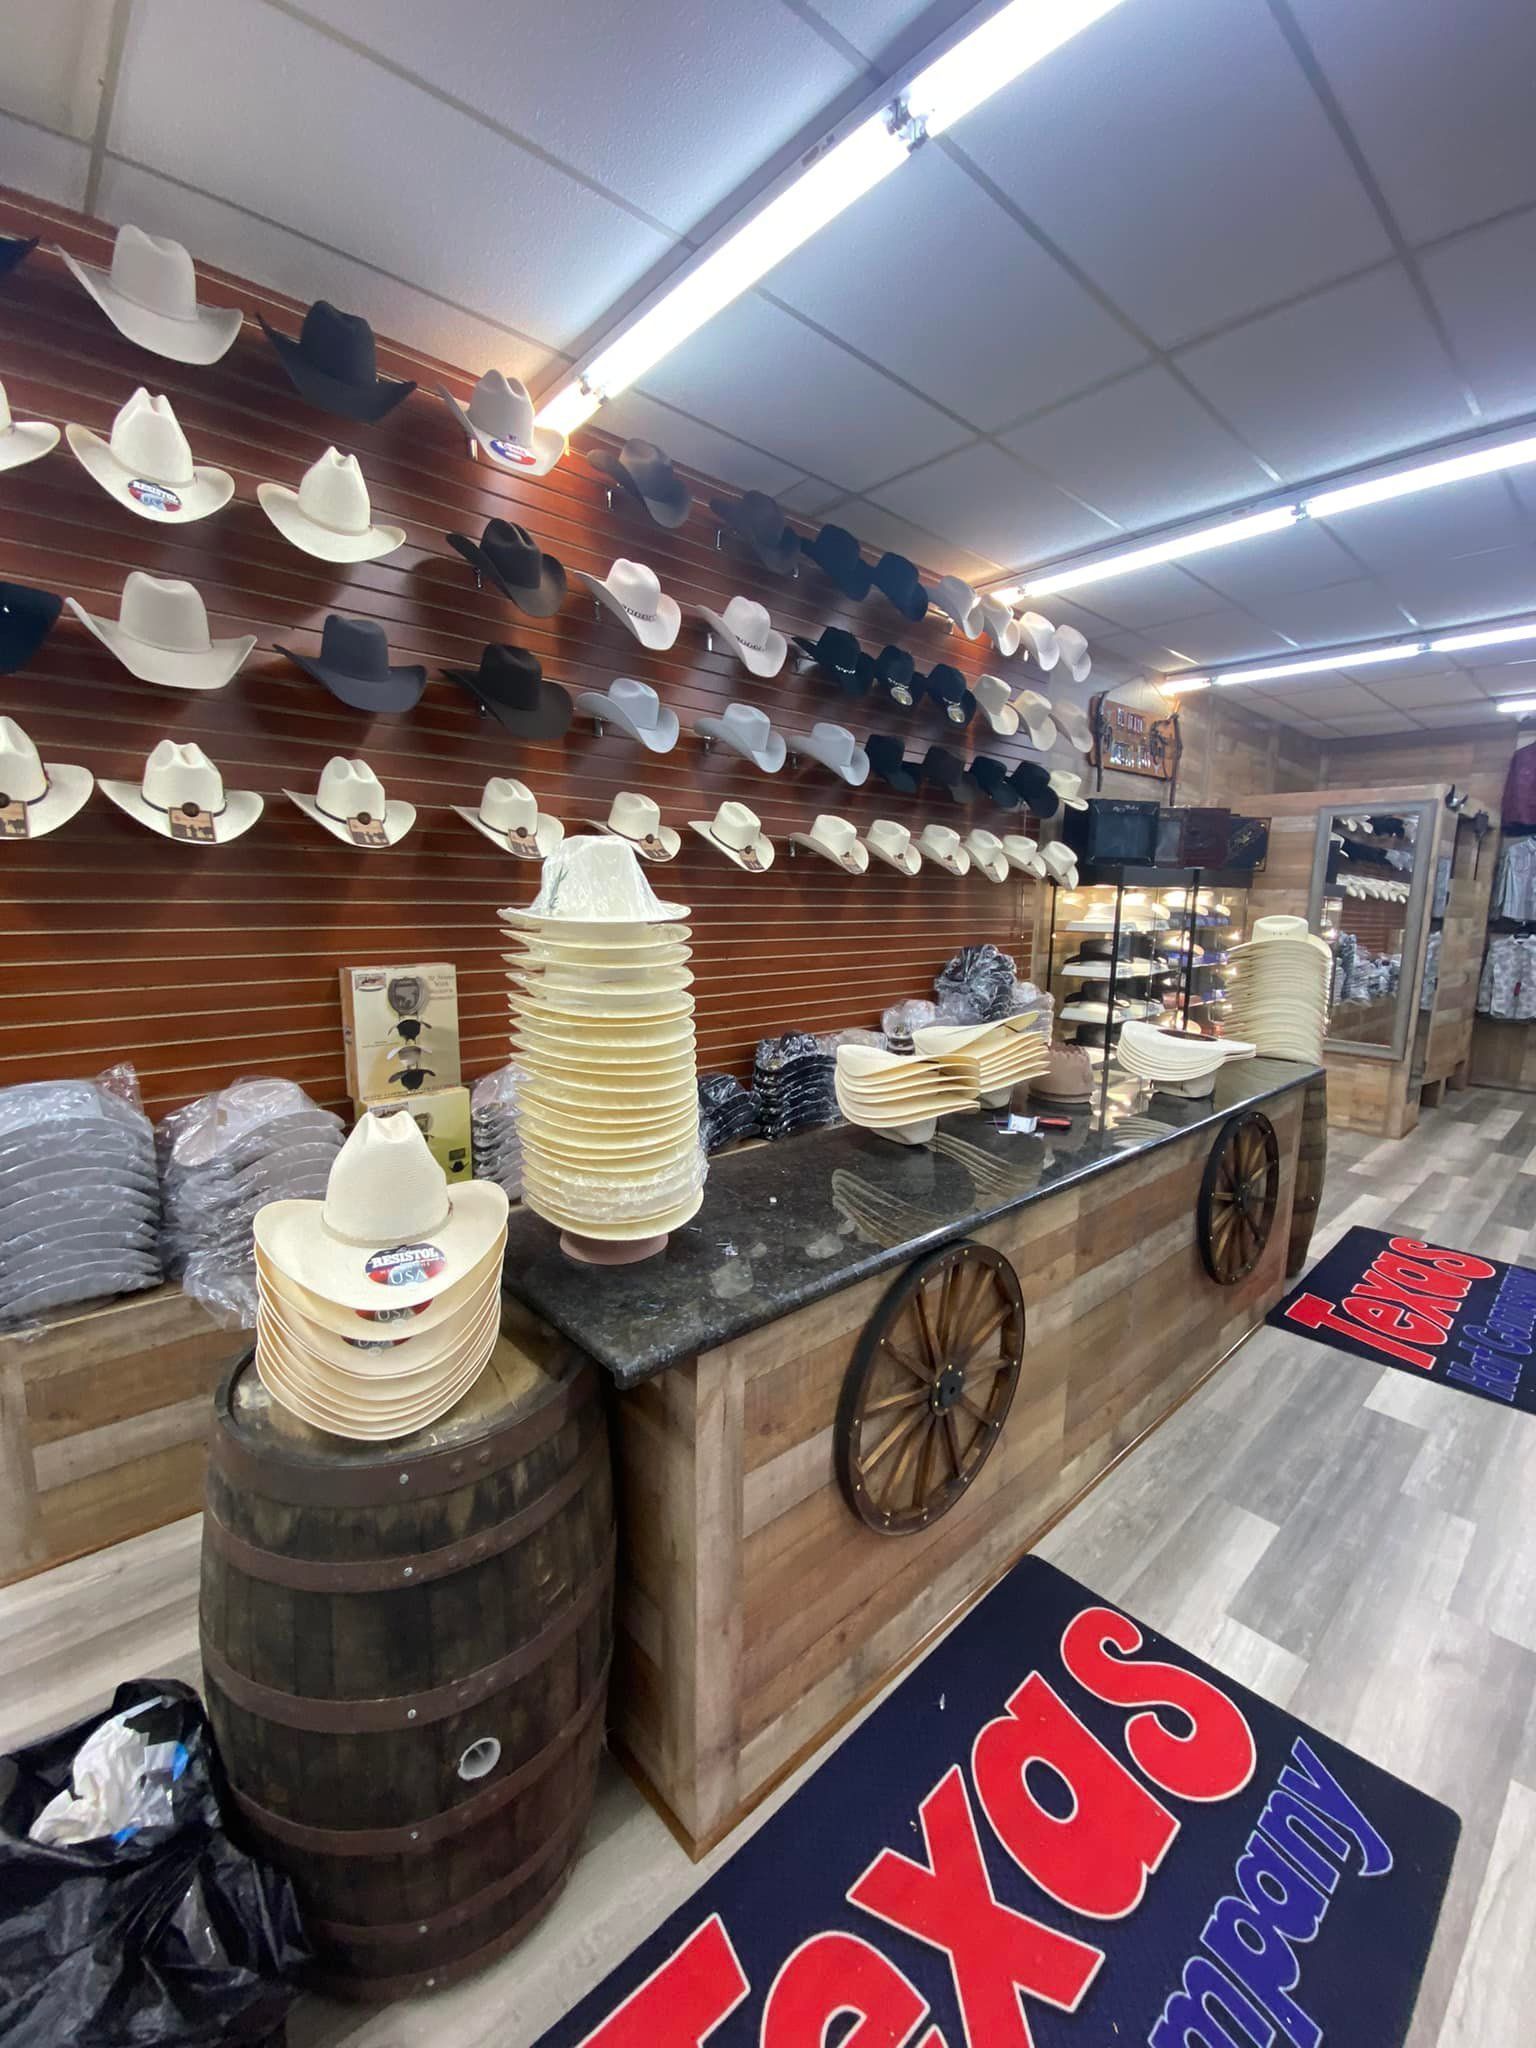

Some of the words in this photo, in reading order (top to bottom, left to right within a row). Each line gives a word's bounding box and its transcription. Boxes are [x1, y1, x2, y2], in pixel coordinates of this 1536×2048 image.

[371, 1247, 439, 1269] RESISTOL
[390, 1266, 428, 1285] USA
[1283, 1236, 1497, 1371] Texas
[1446, 1340, 1523, 1402] Hat
